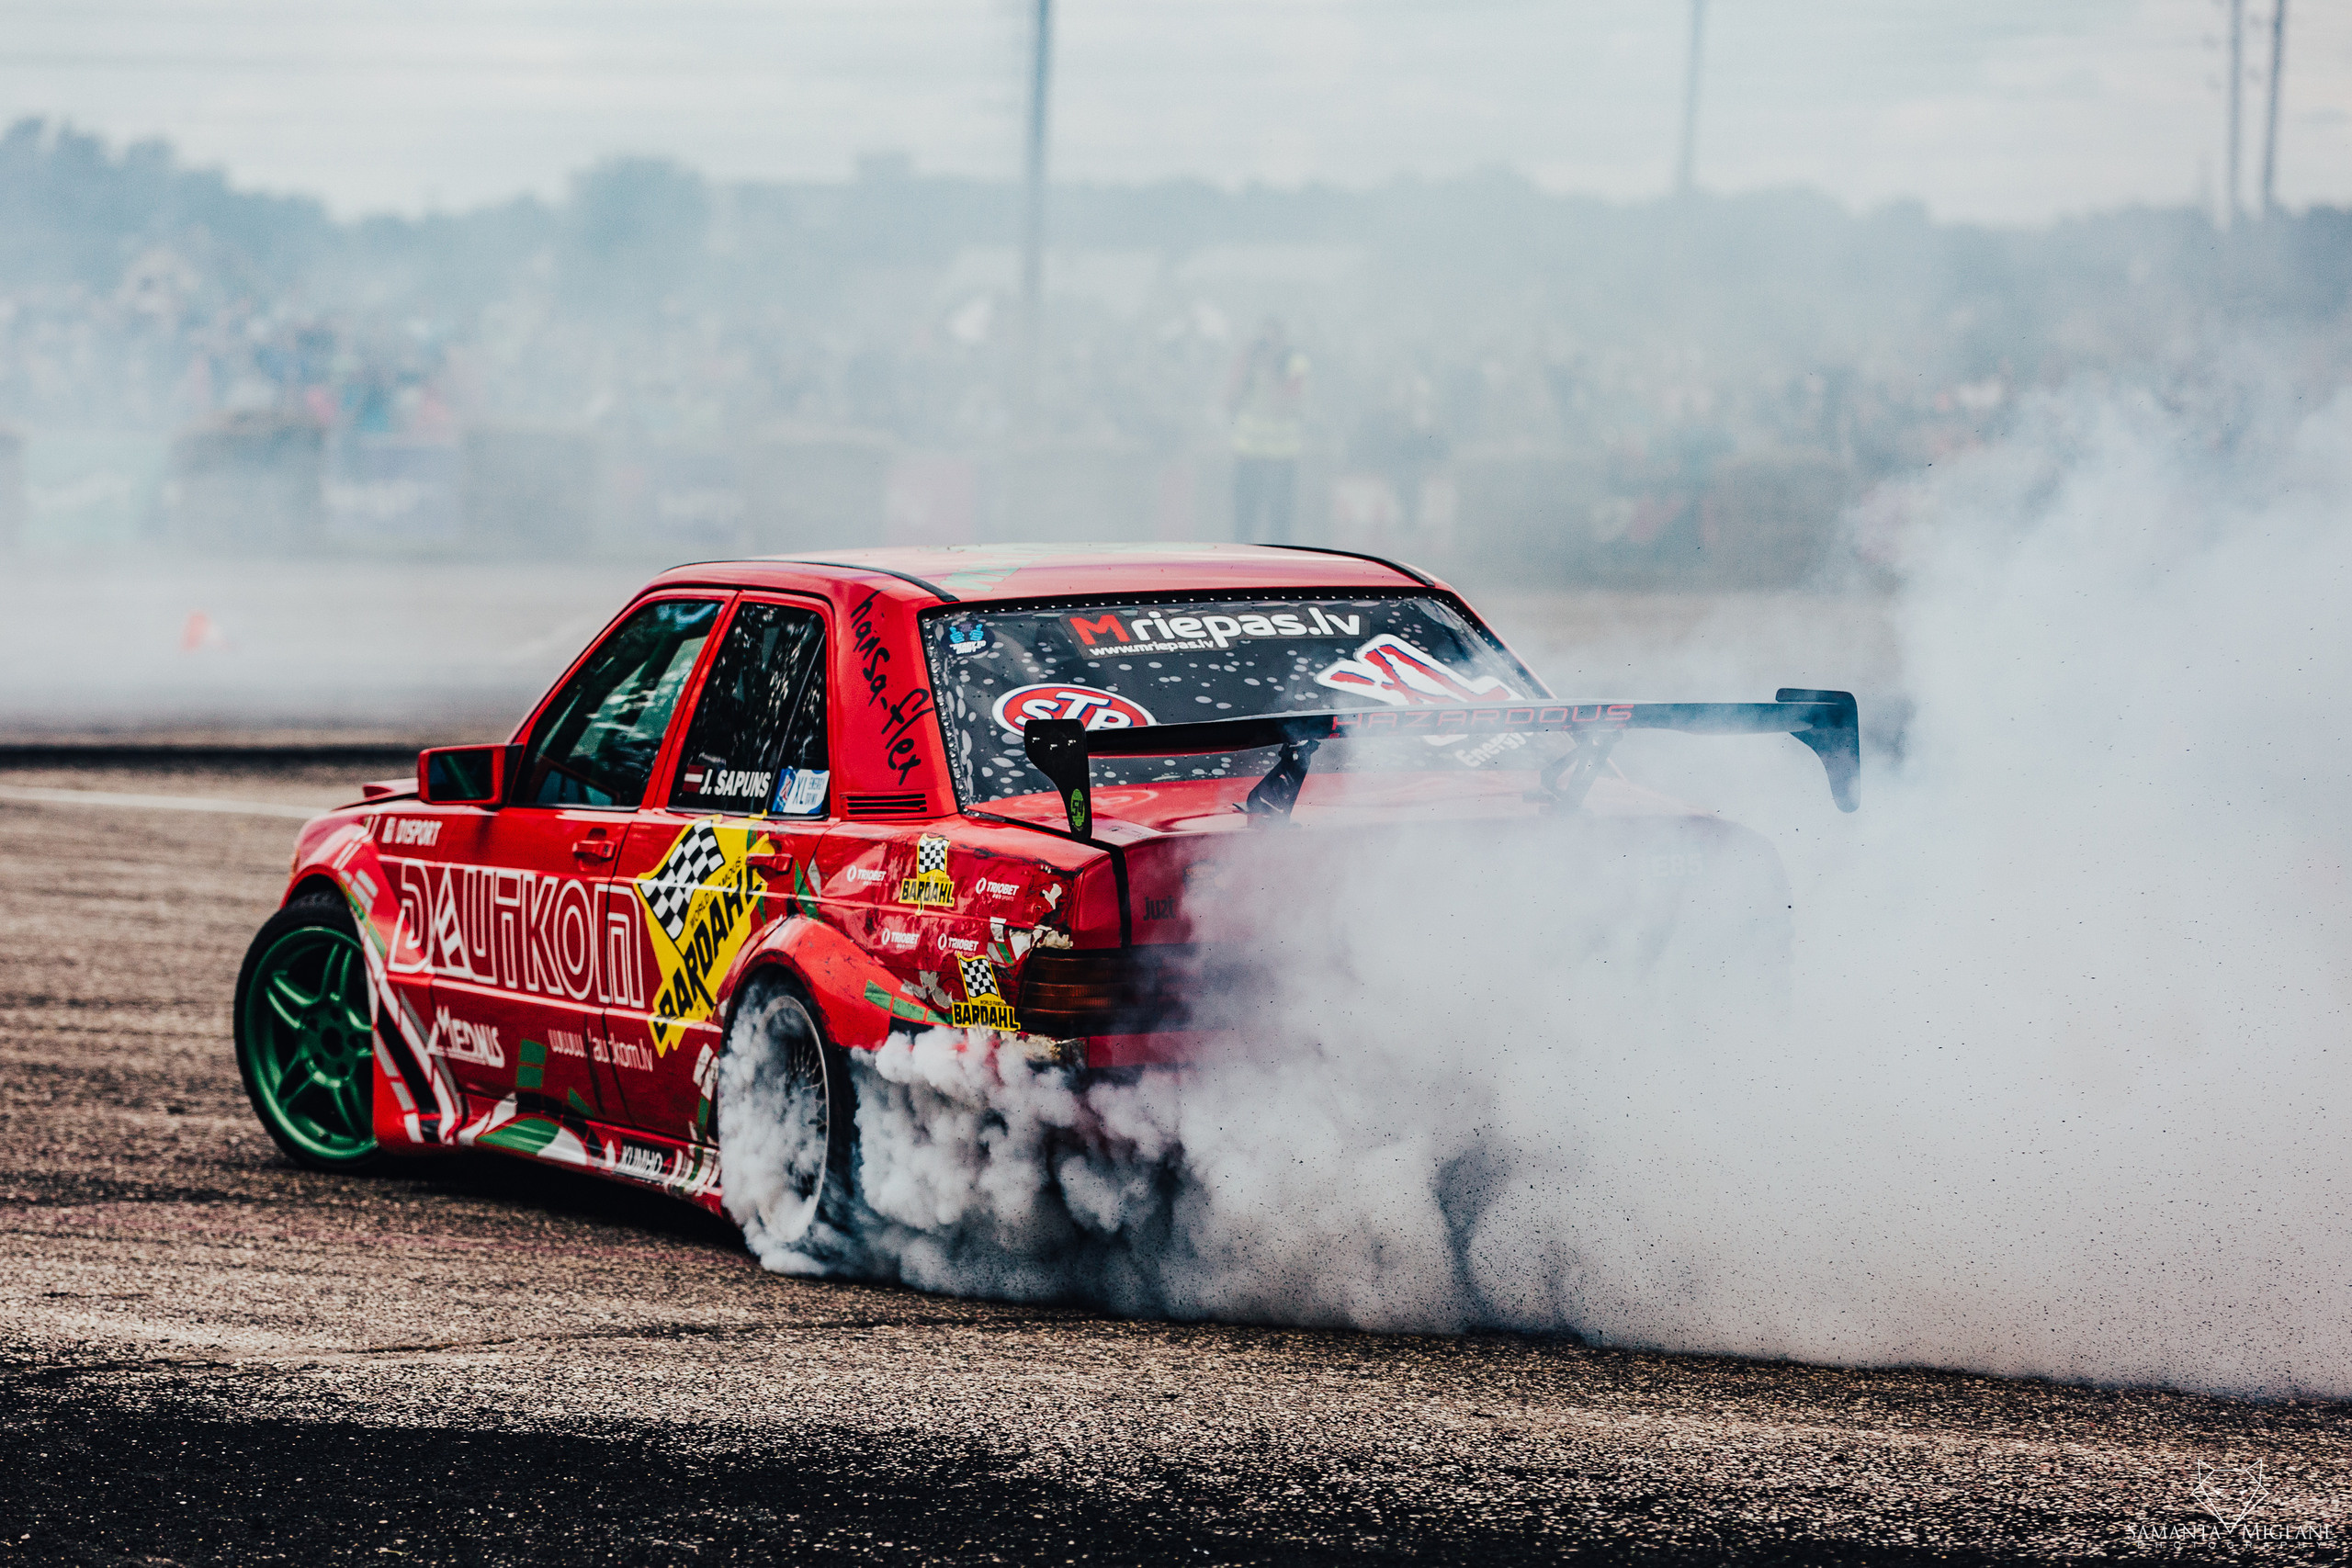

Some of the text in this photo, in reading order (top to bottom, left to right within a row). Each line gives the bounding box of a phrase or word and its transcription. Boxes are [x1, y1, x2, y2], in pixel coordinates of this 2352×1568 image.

[1069, 607, 1360, 649] Mriepas.lv
[1089, 637, 1215, 657] www.mriepas.lv
[1331, 704, 1634, 730] HAZARDOUS
[699, 768, 772, 798] J. SAPUNS
[857, 868, 887, 882] TRIOBET
[901, 880, 953, 904] BARDAHL
[986, 881, 1020, 896] TRIOBET
[890, 931, 920, 945] TRIOBET
[947, 937, 979, 952] TRIOBET
[653, 863, 765, 1044] BARDAHL
[953, 1004, 1020, 1029] BARDAHL
